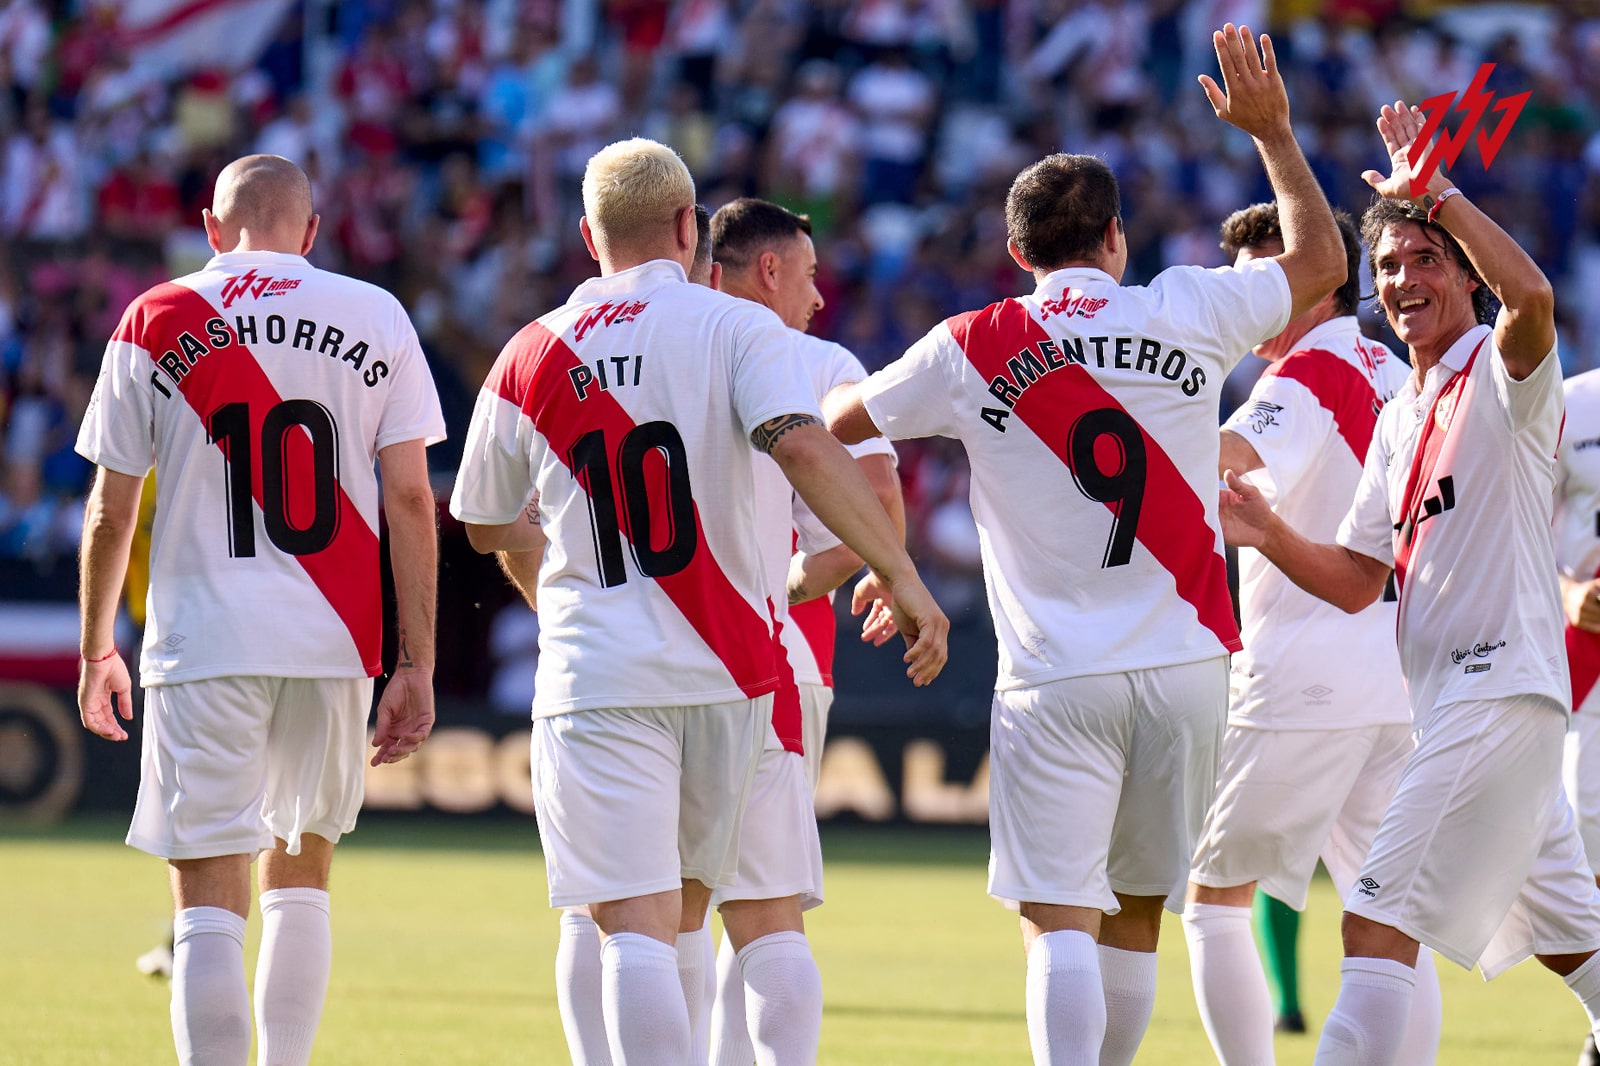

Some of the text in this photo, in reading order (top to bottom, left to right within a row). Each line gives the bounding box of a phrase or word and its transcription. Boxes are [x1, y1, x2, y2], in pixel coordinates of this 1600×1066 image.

[151, 314, 390, 399] TRASHORRAS
[568, 355, 643, 401] PITI
[980, 336, 1207, 433] ARMENTEROS
[205, 398, 340, 559] 10
[566, 420, 698, 589] 10
[1067, 407, 1147, 569] 9
[1359, 888, 1376, 898] umbro
